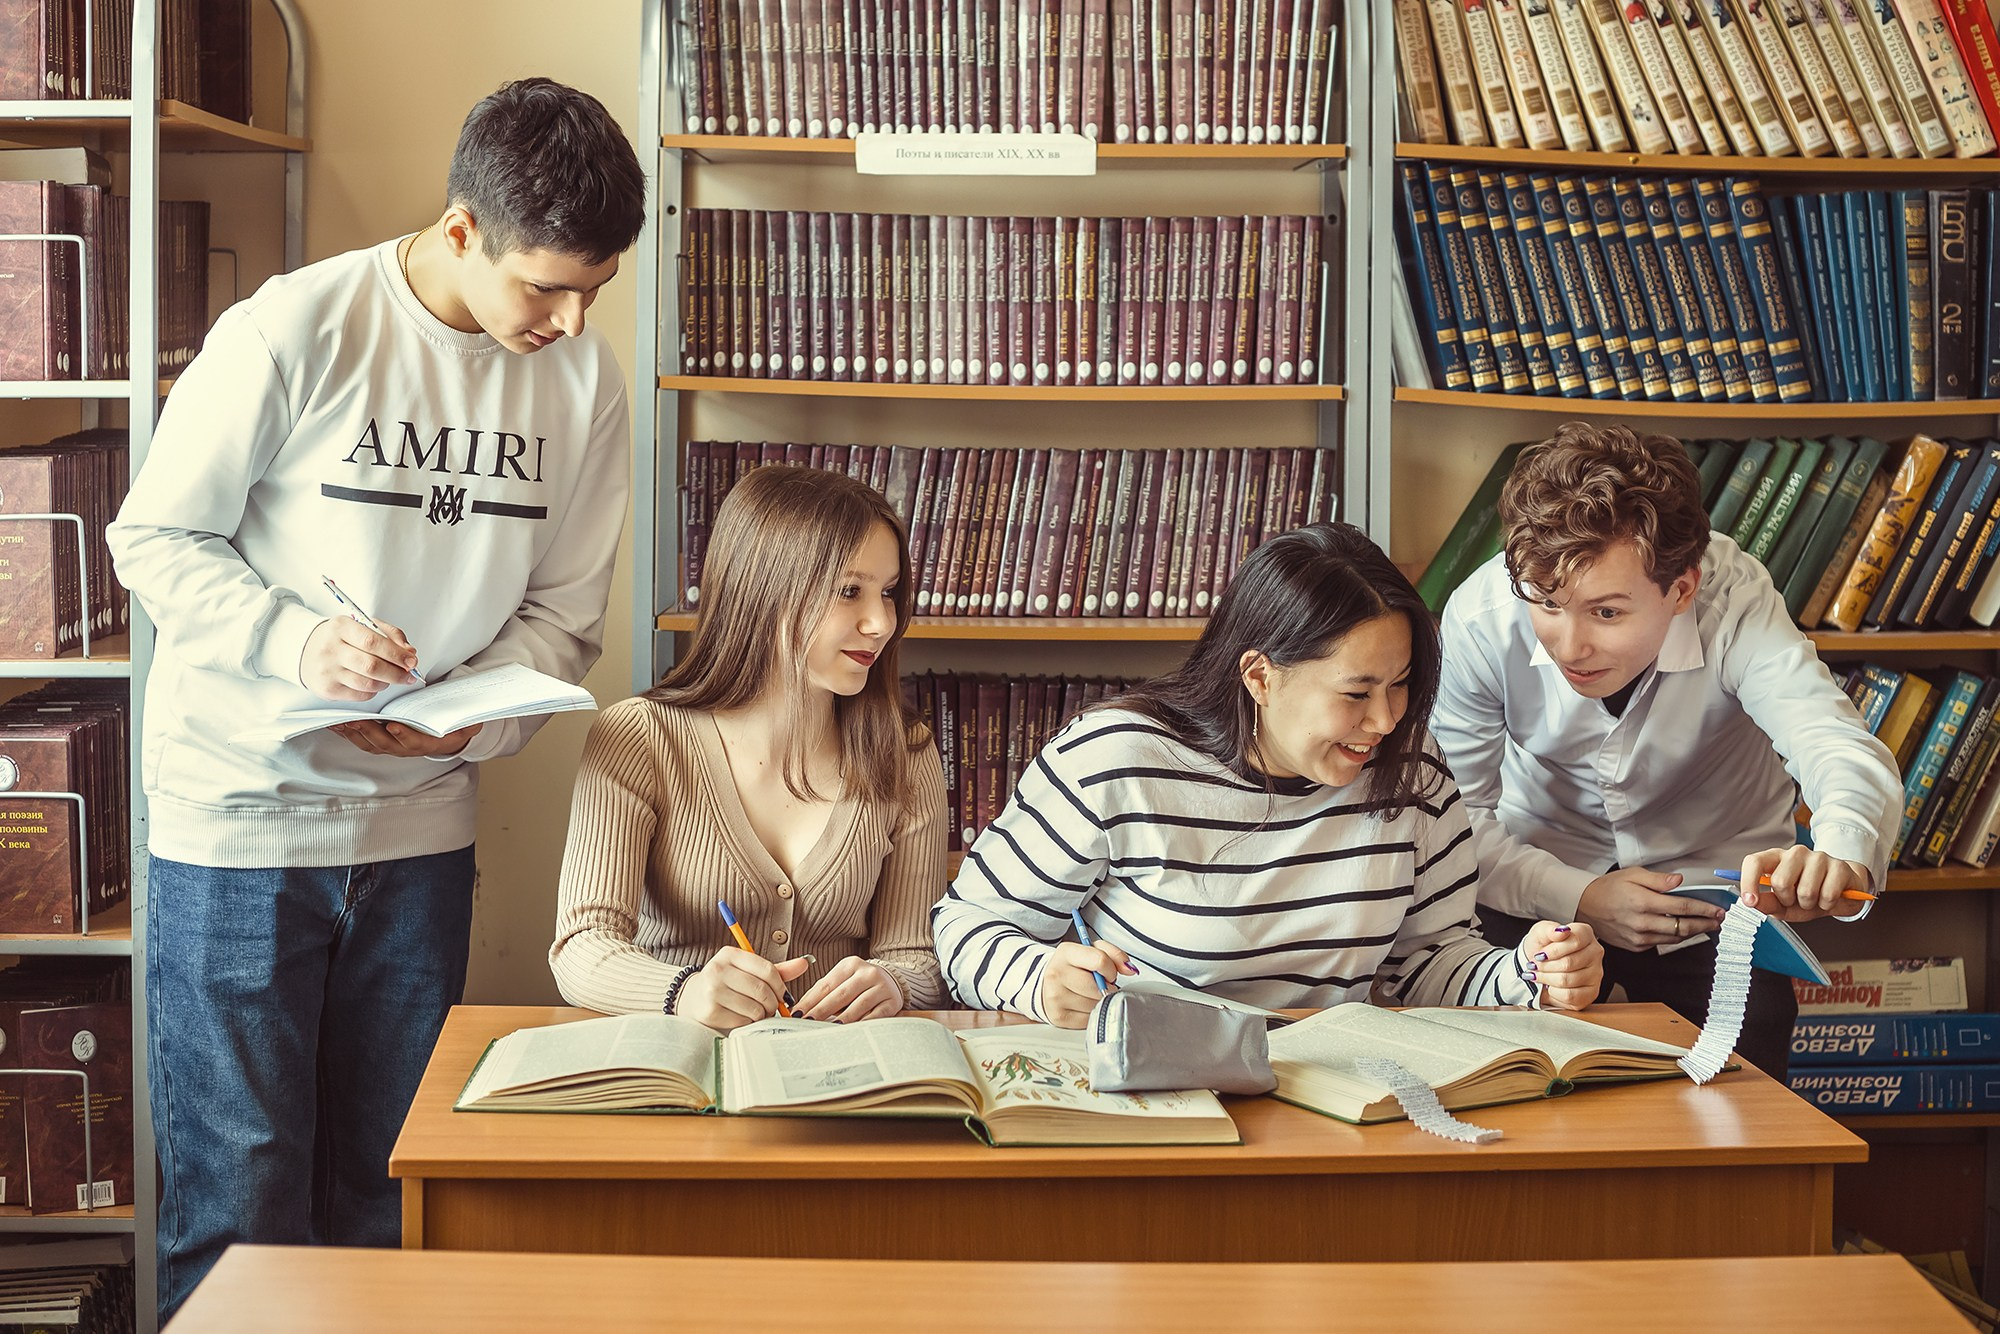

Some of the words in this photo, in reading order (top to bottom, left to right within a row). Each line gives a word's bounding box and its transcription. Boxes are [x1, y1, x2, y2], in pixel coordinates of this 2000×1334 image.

[1882, 26, 1916, 93] ШКОЛЬНАЯ
[896, 148, 931, 159] Поэты
[935, 152, 941, 160] и
[944, 151, 994, 160] писатели
[1942, 303, 1962, 323] 2
[1451, 345, 1457, 355] 1
[1477, 345, 1485, 356] 2
[1506, 347, 1512, 358] 3
[1533, 348, 1541, 358] 4
[1561, 349, 1569, 361] 5
[1590, 351, 1599, 363] 6
[1618, 353, 1625, 364] 7
[1645, 353, 1654, 365] 8
[1673, 354, 1681, 366] 9
[1698, 354, 1713, 367] 10
[1724, 355, 1738, 366] 11
[341, 417, 547, 482] AMIRI
[1741, 476, 1774, 536] РАСТЕНИЙ
[1752, 527, 1773, 560] ИЗНЬ
[1768, 472, 1803, 532] РАСТЕНИЙ
[0, 536, 24, 545] утин
[9, 811, 43, 820] поэзия
[0, 826, 48, 834] половины
[9, 841, 31, 849] века
[1792, 1024, 1876, 1038] ПОЗНАН
[1791, 1037, 1876, 1057] ДРЕВО
[1790, 1075, 1903, 1091] ПОЗНАНИЯ
[1817, 1089, 1901, 1108] ДРЕВО
